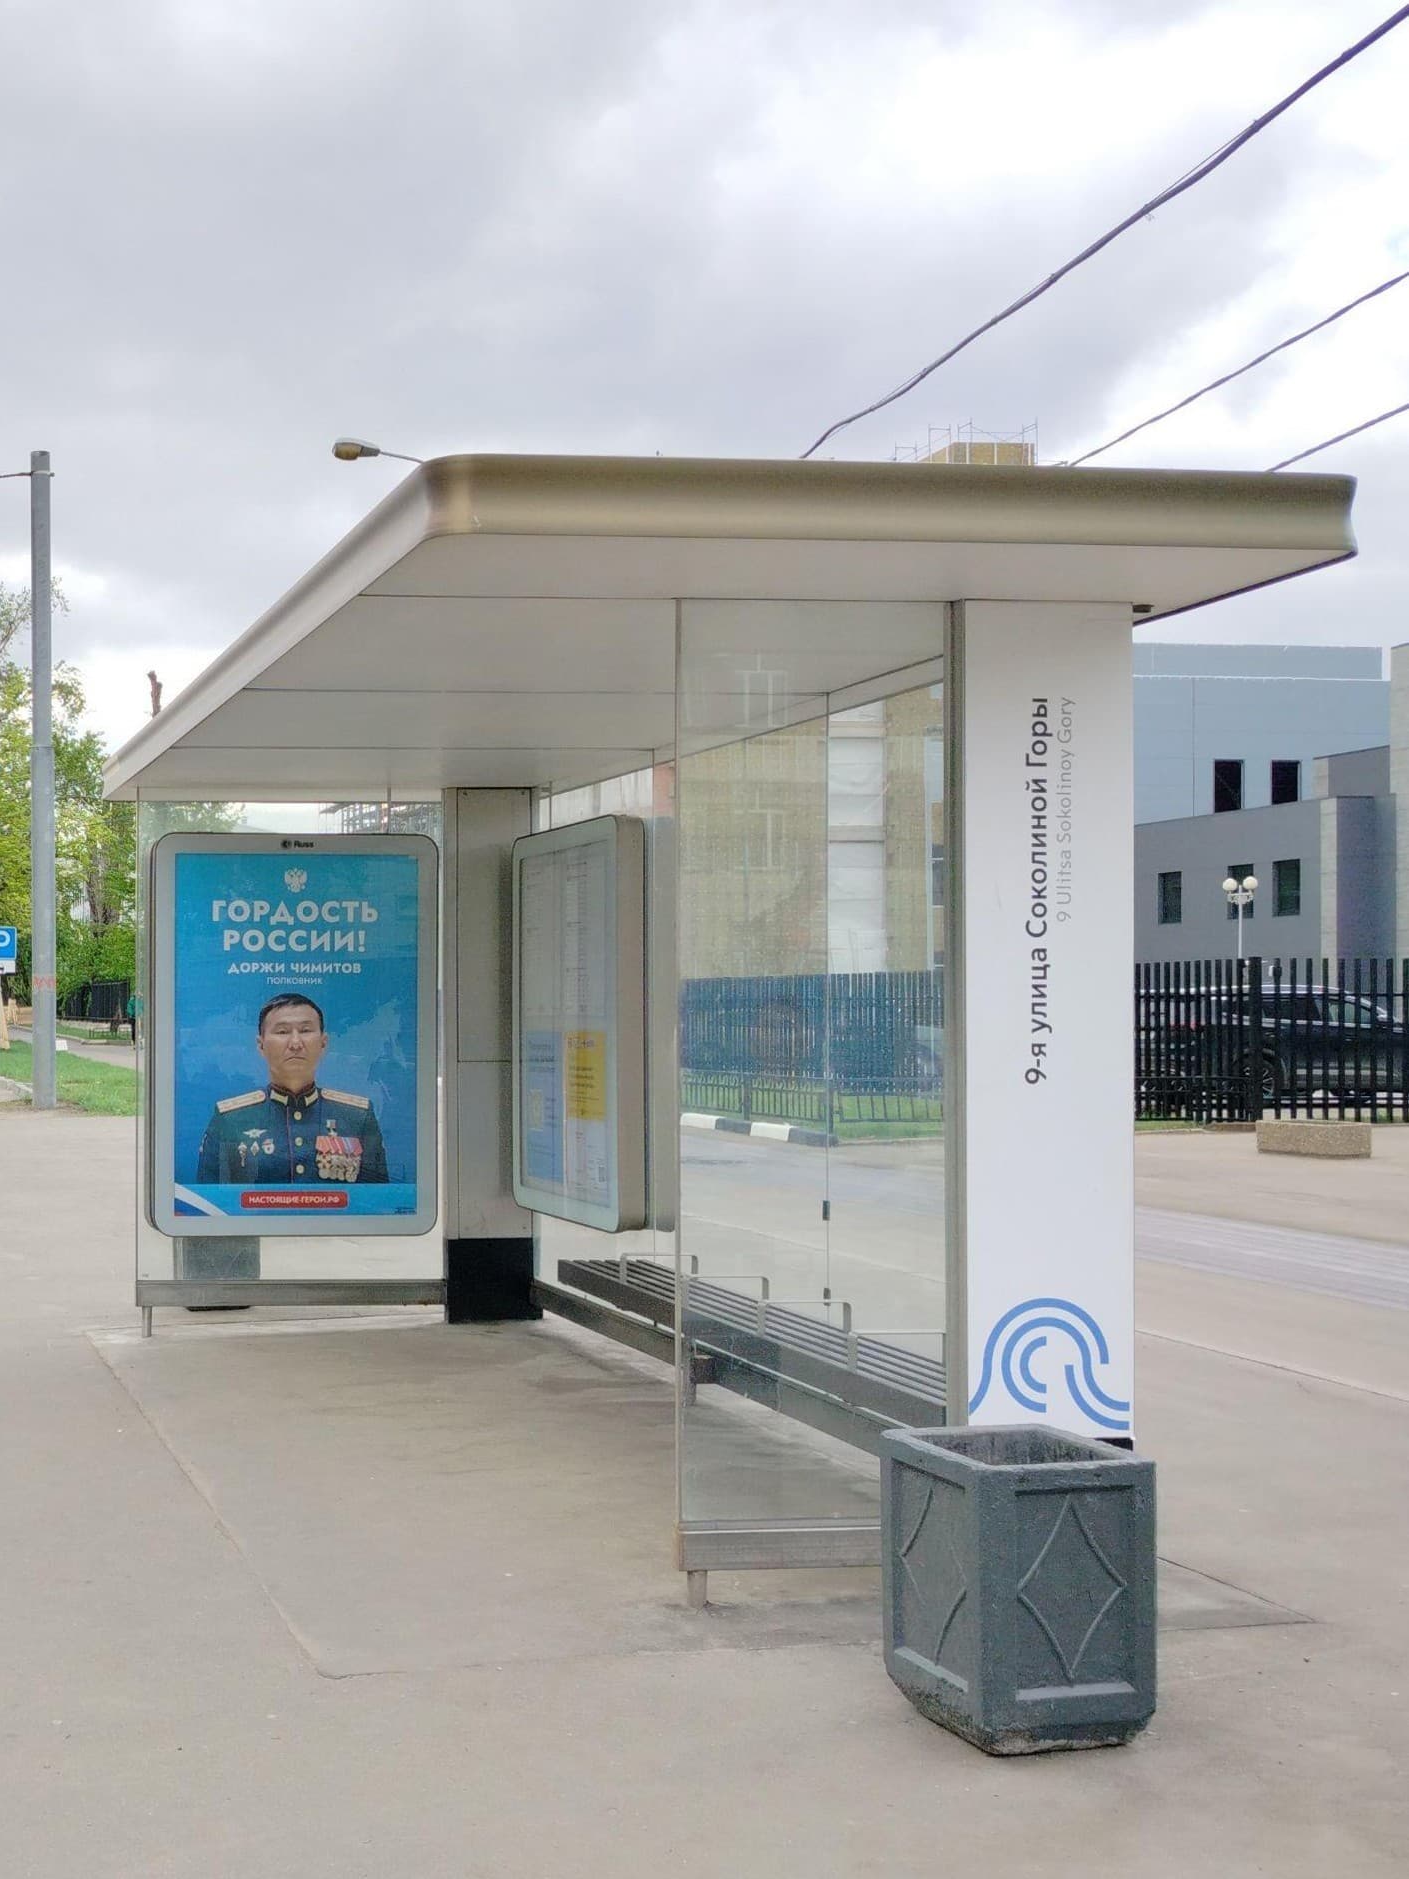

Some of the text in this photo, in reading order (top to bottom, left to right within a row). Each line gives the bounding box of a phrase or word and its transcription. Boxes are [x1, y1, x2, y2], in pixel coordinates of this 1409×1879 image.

[1056, 696, 1076, 922] 9 Ulitsa Sokolinoy Gory
[1025, 697, 1053, 1085] 9-я улица Соколиной Горы
[212, 899, 379, 926] ГОРДОСТЬ
[223, 929, 366, 952] РОССИИ!
[227, 962, 362, 974] ДОРЖИ ЧИМИТОВ
[266, 976, 323, 985] ПОЛКОВНИК
